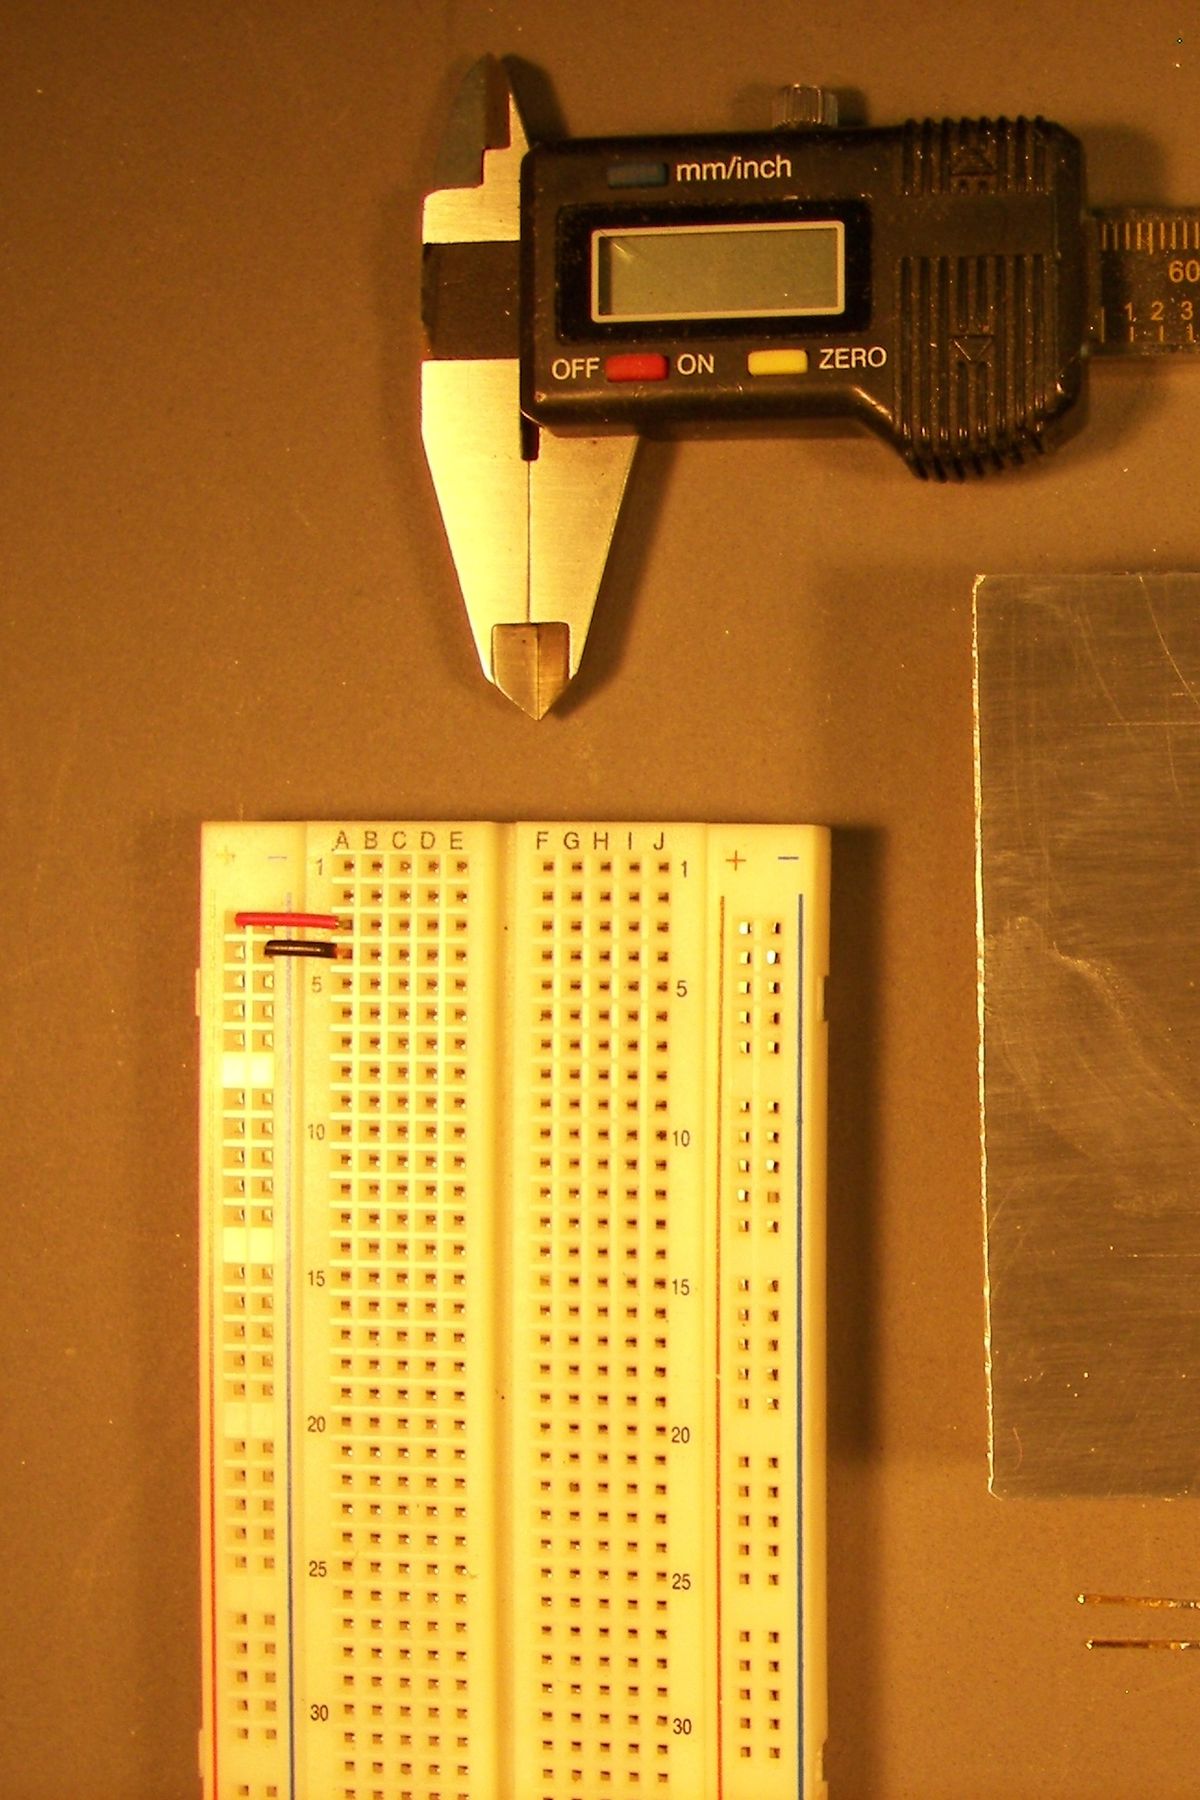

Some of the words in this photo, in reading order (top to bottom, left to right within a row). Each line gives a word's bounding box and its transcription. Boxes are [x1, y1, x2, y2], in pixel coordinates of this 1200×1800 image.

[676, 156, 791, 183] mm/inch
[1169, 261, 1200, 282] 60
[1151, 302, 1163, 320] 2
[1181, 301, 1193, 320] 3
[678, 353, 714, 374] ON
[819, 347, 886, 370] ZERO
[552, 358, 599, 380] OFF
[335, 831, 350, 850] A
[363, 831, 378, 850] B
[392, 831, 407, 850] C
[420, 831, 435, 850] D
[449, 831, 464, 850] E
[535, 831, 549, 851] F
[563, 831, 580, 851] G
[593, 831, 609, 851] H
[654, 831, 666, 851] J
[311, 976, 322, 993] 5
[676, 981, 687, 998] 5
[308, 1123, 325, 1141] 10
[673, 1129, 691, 1148] 10
[308, 1270, 325, 1288] 15
[672, 1278, 690, 1296] 15
[308, 1416, 326, 1433] 20
[671, 1426, 690, 1444] 20
[309, 1560, 327, 1577] 25
[672, 1573, 691, 1591] 25
